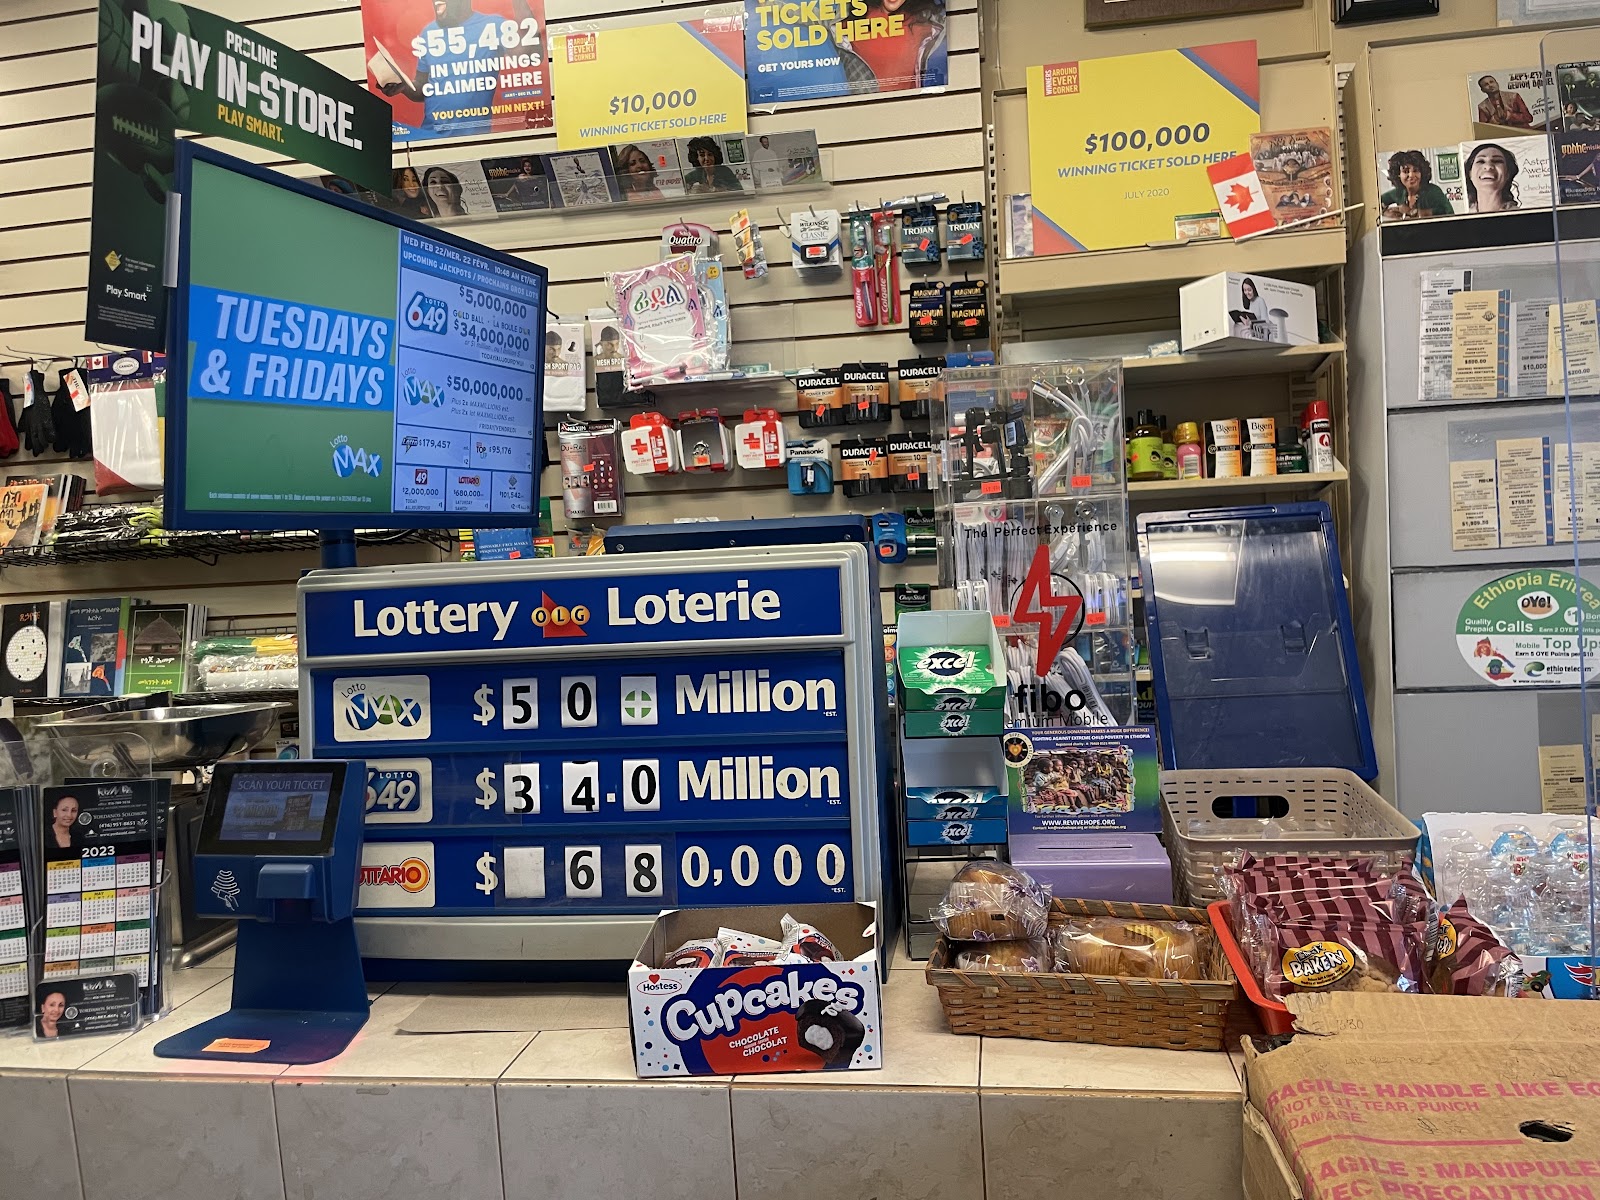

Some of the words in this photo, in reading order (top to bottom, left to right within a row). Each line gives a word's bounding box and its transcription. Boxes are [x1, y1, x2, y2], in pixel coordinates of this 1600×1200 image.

[755, 0, 868, 27] TICKETS
[411, 18, 540, 59] $55,482
[756, 26, 828, 51] SOLD
[836, 14, 905, 44] HERE
[226, 30, 278, 70] PROLINE
[574, 44, 594, 53] EVERY
[574, 53, 595, 61] CORNER
[757, 63, 778, 73] GET
[779, 59, 814, 71] YOURS
[816, 57, 841, 68] NOW
[430, 63, 449, 79] IN
[451, 53, 541, 75] WINNINGS
[1052, 67, 1078, 77] AROUND
[131, 11, 211, 91] PLAY
[218, 51, 362, 150] IN-STORE.
[422, 77, 497, 97] CLAIMED
[500, 71, 543, 88] HERE
[1052, 75, 1078, 87] EVERY
[1052, 84, 1079, 95] CORNER
[432, 112, 454, 120] YOU
[456, 109, 489, 118] COULD
[491, 104, 512, 114] WIN
[514, 100, 545, 111] NEXT!
[609, 88, 697, 116] $10,000
[218, 104, 244, 127] PLAY
[246, 114, 285, 143] SMART.
[580, 123, 629, 138] WINNING
[630, 119, 668, 132] TICKET
[669, 116, 697, 128] SOLD
[699, 113, 727, 125] HERE
[1085, 122, 1211, 155] $100,000
[1057, 163, 1117, 179] WINNING
[1119, 158, 1163, 173] TICKET
[1166, 155, 1201, 169] SOLD
[1203, 150, 1238, 165] HERE
[1124, 189, 1145, 200] JULY
[1146, 187, 1170, 198] 2020
[903, 227, 935, 236] TROJAN
[948, 223, 981, 232] TROJAN
[669, 234, 703, 246] Quattro
[403, 235, 418, 247] WED
[420, 241, 434, 252] FEB
[435, 246, 461, 261] 22/MER.
[463, 255, 471, 265] 22
[472, 258, 490, 271] FÉVR.
[494, 266, 510, 277] 10:48
[511, 271, 520, 280] AM
[520, 275, 537, 286] ET/HE
[403, 251, 438, 269] UPCOMING
[438, 262, 472, 279] JACKPOTS
[477, 275, 509, 291] PROCHAINS
[510, 285, 525, 297] GROS
[525, 290, 539, 300] LOTS
[106, 284, 122, 298] Play
[124, 289, 148, 301] Smart
[880, 277, 888, 313] Colgate
[913, 289, 940, 297] MAGNUM
[953, 288, 981, 296] MAGNUM
[425, 297, 445, 308] LOTTO
[459, 285, 527, 319] $5,000,000
[854, 287, 862, 319] Colgate
[453, 309, 470, 320] GOLD
[471, 314, 484, 324] BALL
[501, 323, 517, 333] BOULE
[909, 309, 943, 318] MAGNUM
[951, 309, 985, 318] MAGNUM
[216, 294, 388, 360] TUESDAYS
[454, 319, 530, 352] $34,000,000
[200, 349, 231, 394] &
[244, 352, 385, 406] FRIDAYS
[844, 372, 886, 381] DURACELL
[900, 367, 942, 377] DURACELL
[447, 375, 523, 401] $50,000,000
[799, 378, 840, 387] DURACELL
[403, 376, 445, 408] MAX
[1216, 424, 1237, 434] Bigen
[1251, 422, 1273, 431] Bigen
[330, 434, 348, 449] Lotto
[419, 439, 451, 449] $179,457
[890, 442, 931, 451] DURACELL
[489, 446, 512, 455] $95,176
[790, 448, 824, 456] Panasonic
[332, 444, 382, 478] MAX
[415, 472, 427, 484] 49
[403, 487, 439, 496] $2,000,000
[454, 490, 480, 498] $680,000
[994, 526, 1042, 538] Perfect
[1044, 522, 1117, 536] Experience
[1473, 573, 1543, 610] Ethiopia
[354, 600, 519, 640] Lottery
[534, 606, 588, 626] OLG
[608, 580, 781, 626] Loterie
[1465, 618, 1491, 626] Quality
[1496, 620, 1533, 632] Calls
[1543, 638, 1571, 651] Top
[916, 651, 976, 669] excel
[341, 682, 367, 699] Lotto
[676, 669, 836, 715] Million
[1014, 683, 1087, 713] fibo
[345, 692, 422, 731] MAX
[934, 698, 977, 711] excel
[940, 715, 970, 728] excel
[1059, 712, 1109, 726] Mobile
[238, 780, 263, 790] SCAN
[266, 780, 291, 789] YOUR
[293, 780, 325, 790] TICKET
[679, 755, 840, 801] Million
[936, 807, 978, 820] excel
[941, 823, 972, 836] excel
[82, 846, 115, 858] 2023
[1289, 950, 1347, 977] BAKERY
[643, 982, 678, 991] Hostess
[666, 970, 859, 1041] Cupcakes
[729, 1026, 779, 1048] CHOCOLATE
[743, 1037, 787, 1057] CHOCOLAT
[1376, 1083, 1488, 1098] HANDLE
[1496, 1082, 1564, 1097] LIKE
[1281, 1098, 1313, 1116] NOT
[1318, 1096, 1360, 1111] CUT,
[1362, 1100, 1414, 1113] TEAR,
[1418, 1101, 1480, 1112] PUNCH
